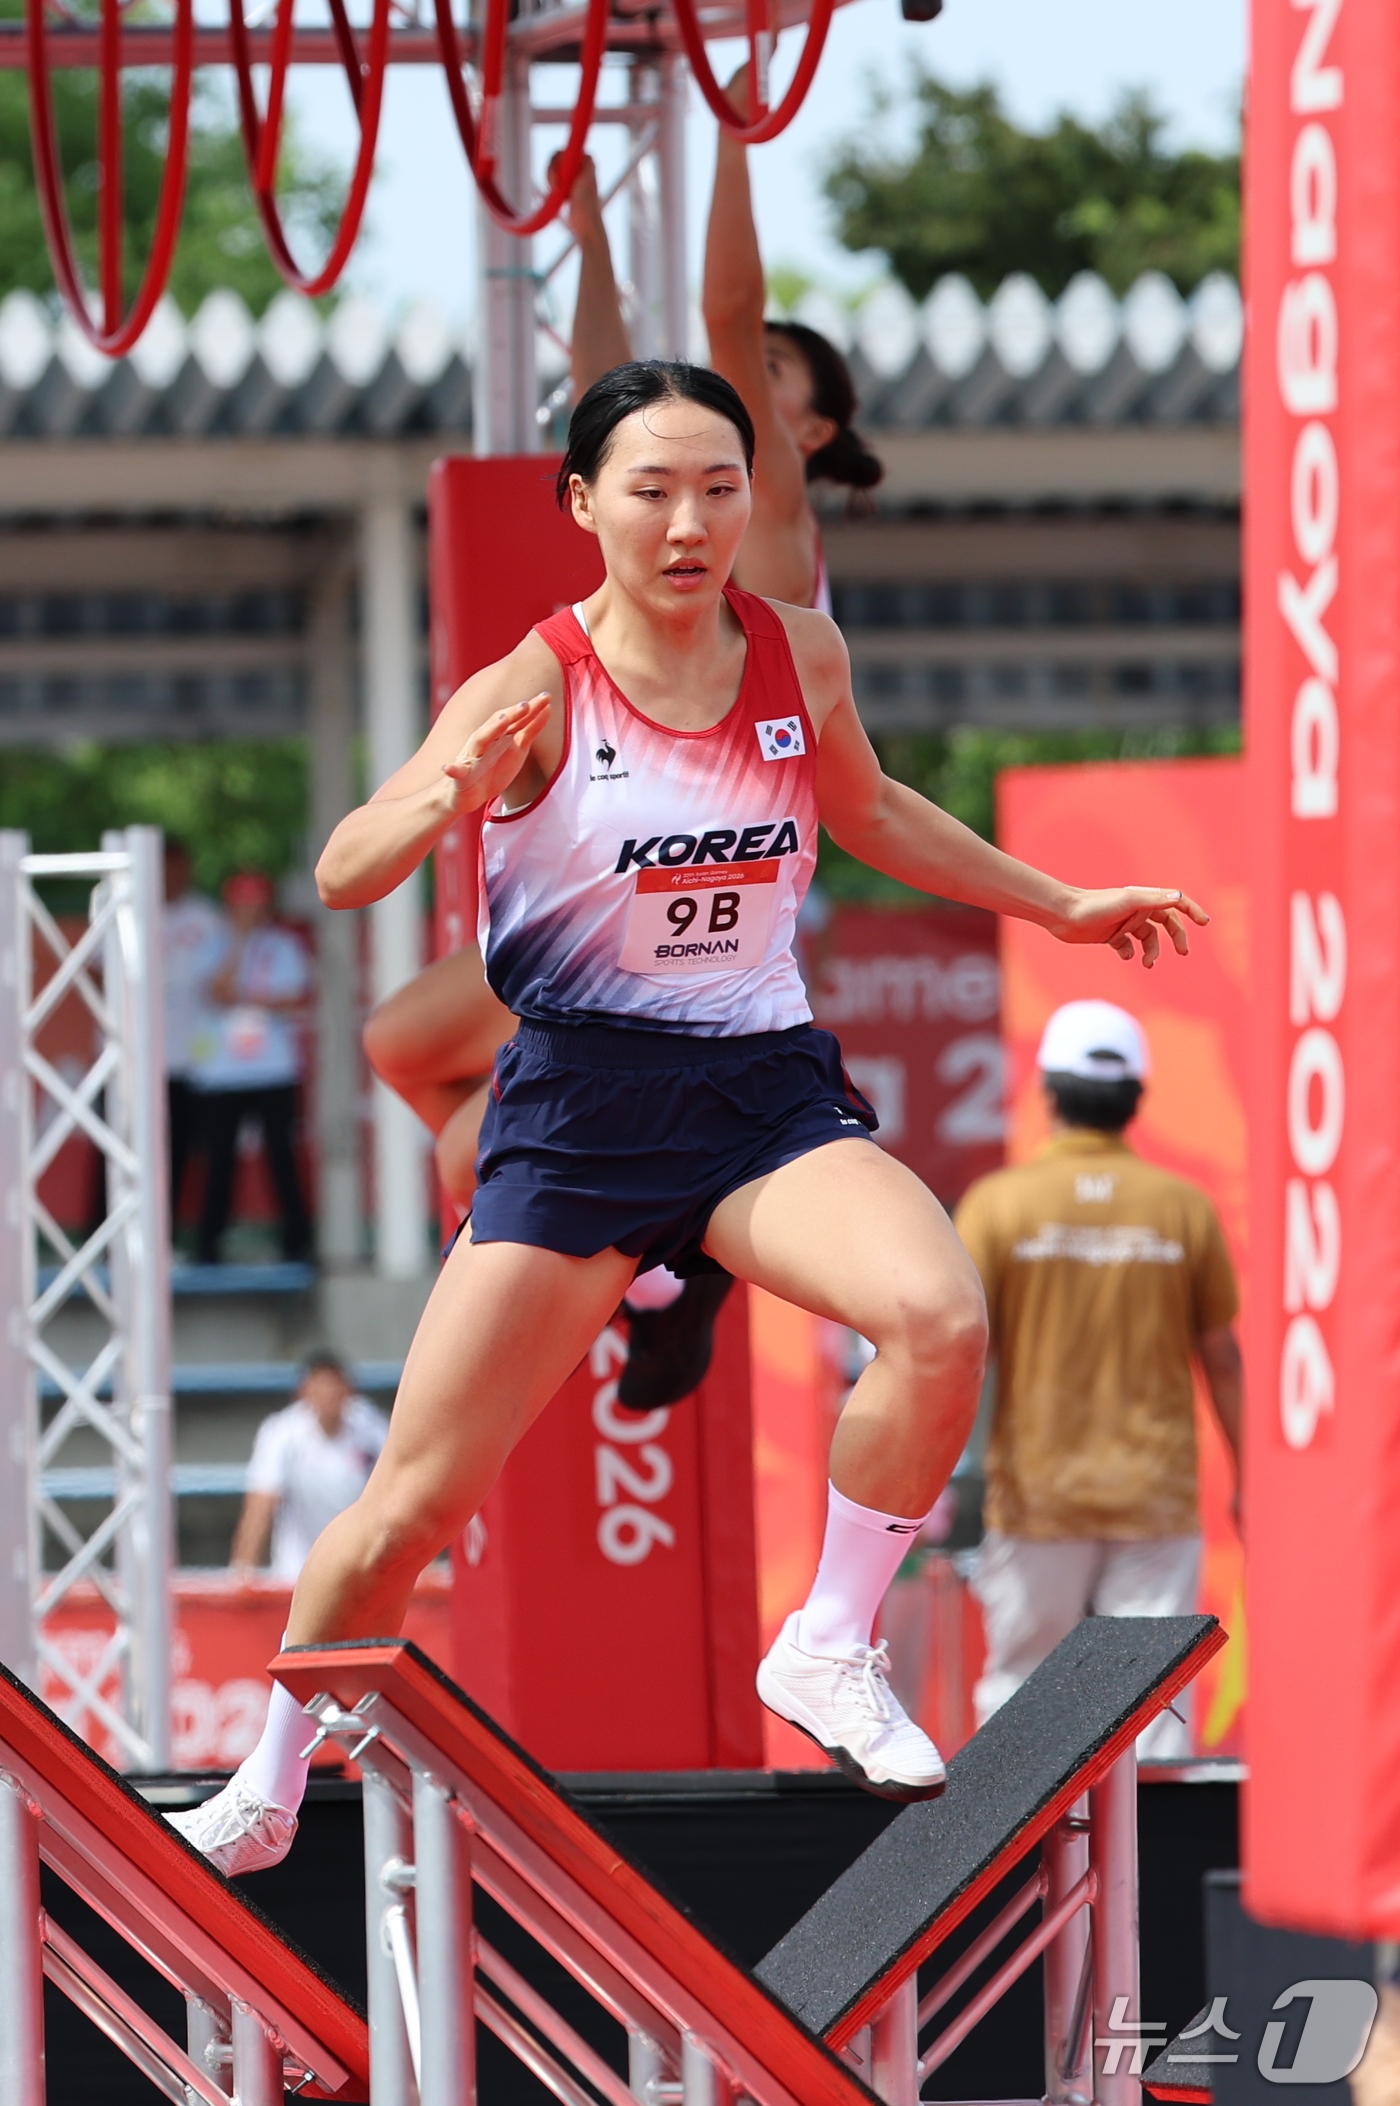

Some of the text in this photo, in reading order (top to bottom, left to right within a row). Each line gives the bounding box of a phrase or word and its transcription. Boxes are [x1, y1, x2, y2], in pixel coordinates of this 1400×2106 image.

[1276, 0, 1347, 1451] Nagoya 2026
[614, 820, 799, 874] KOREA
[681, 872, 745, 884] Aichi-Nagoya 2026
[666, 891, 741, 937] 9 B
[653, 938, 739, 958] BORNAN
[653, 953, 738, 967] SPORTS TECHNOLOGY
